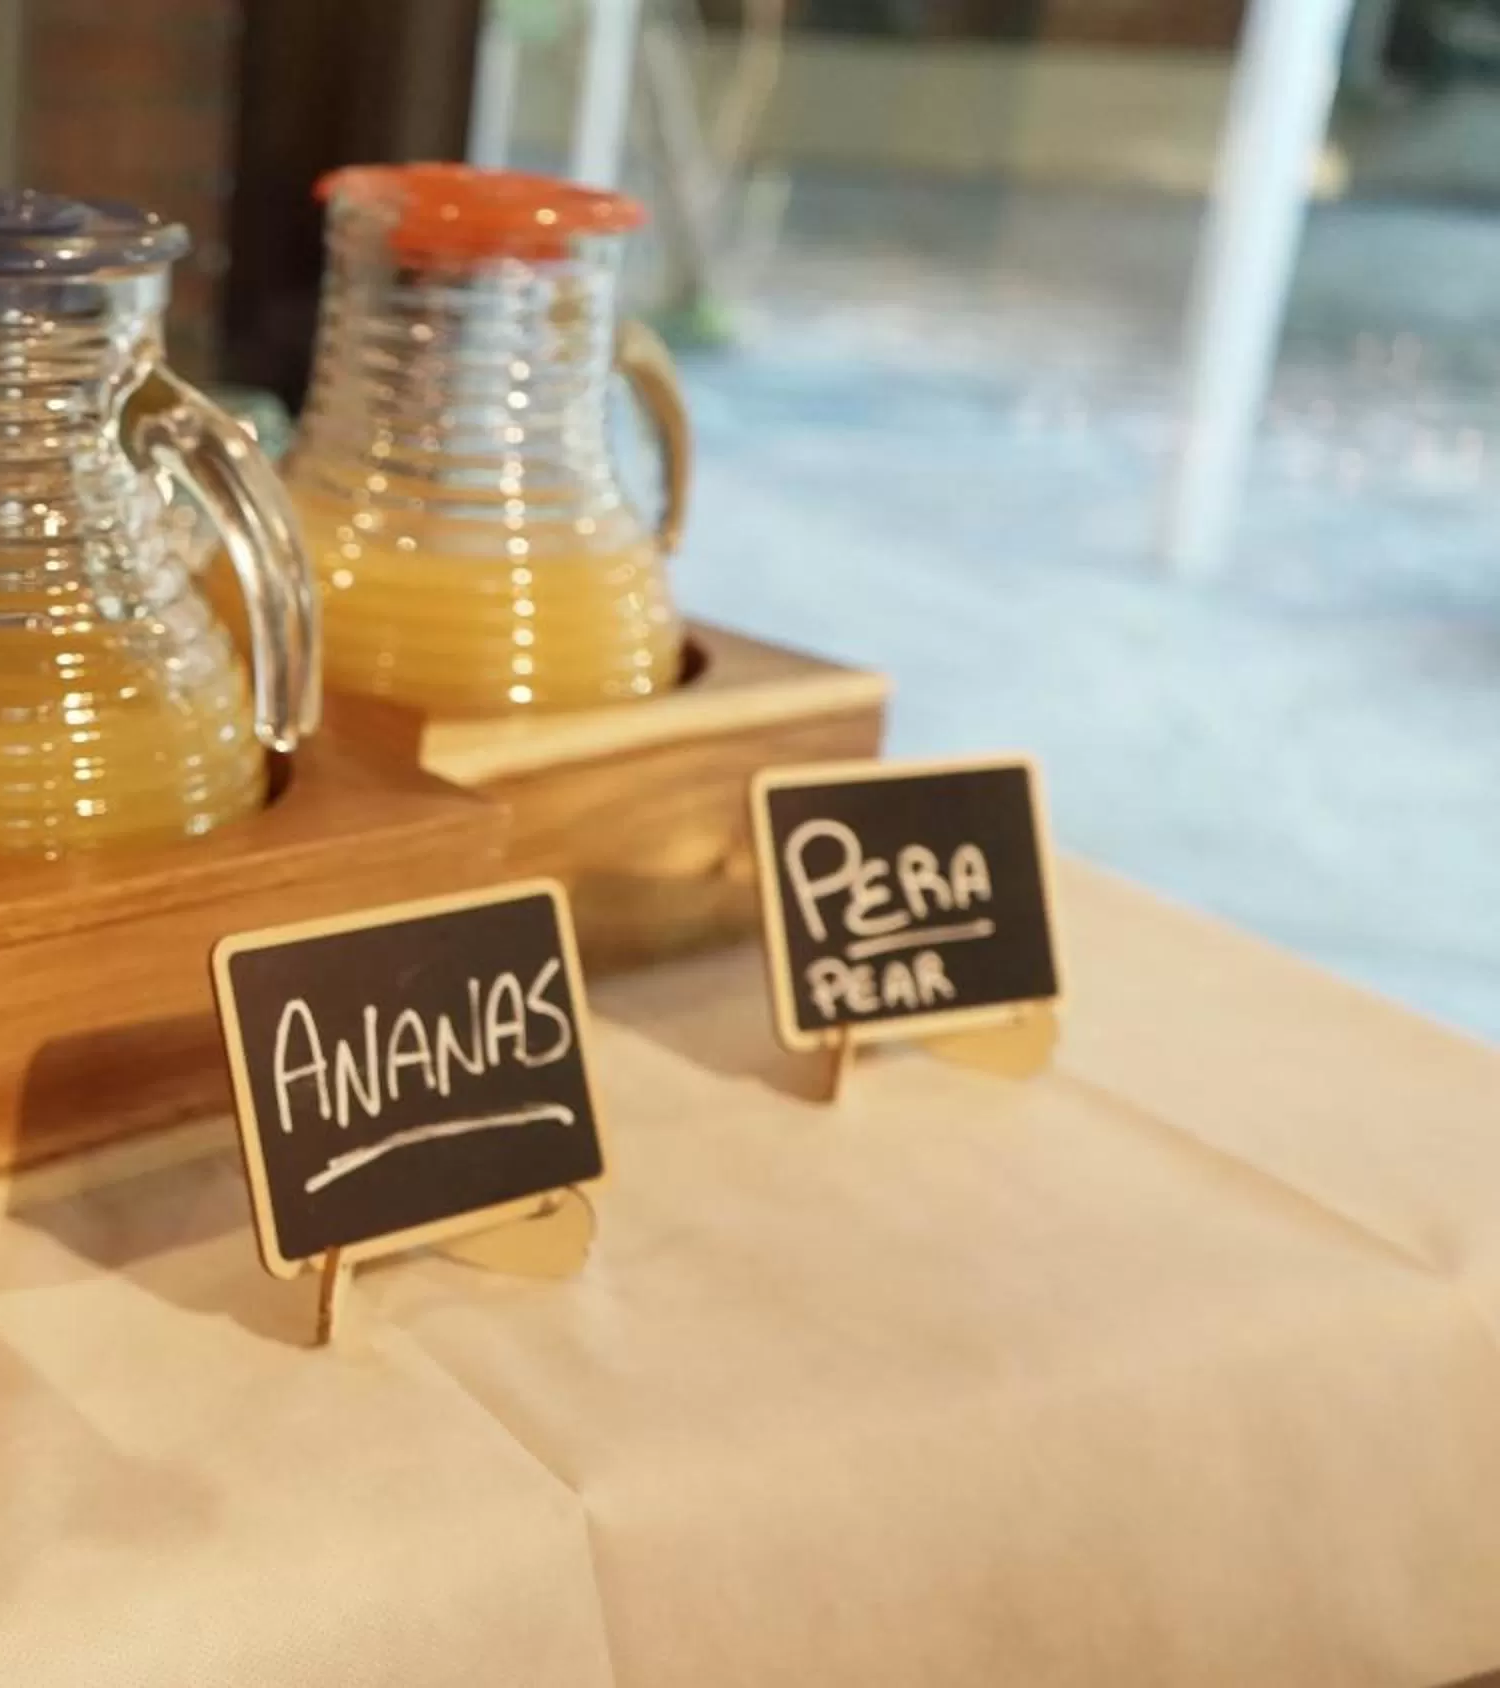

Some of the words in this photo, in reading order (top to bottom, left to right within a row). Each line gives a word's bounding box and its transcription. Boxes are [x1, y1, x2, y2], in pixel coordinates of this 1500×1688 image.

[783, 818, 992, 942] PERA
[273, 958, 573, 1134] ANANAS
[806, 950, 956, 1020] PEAR
